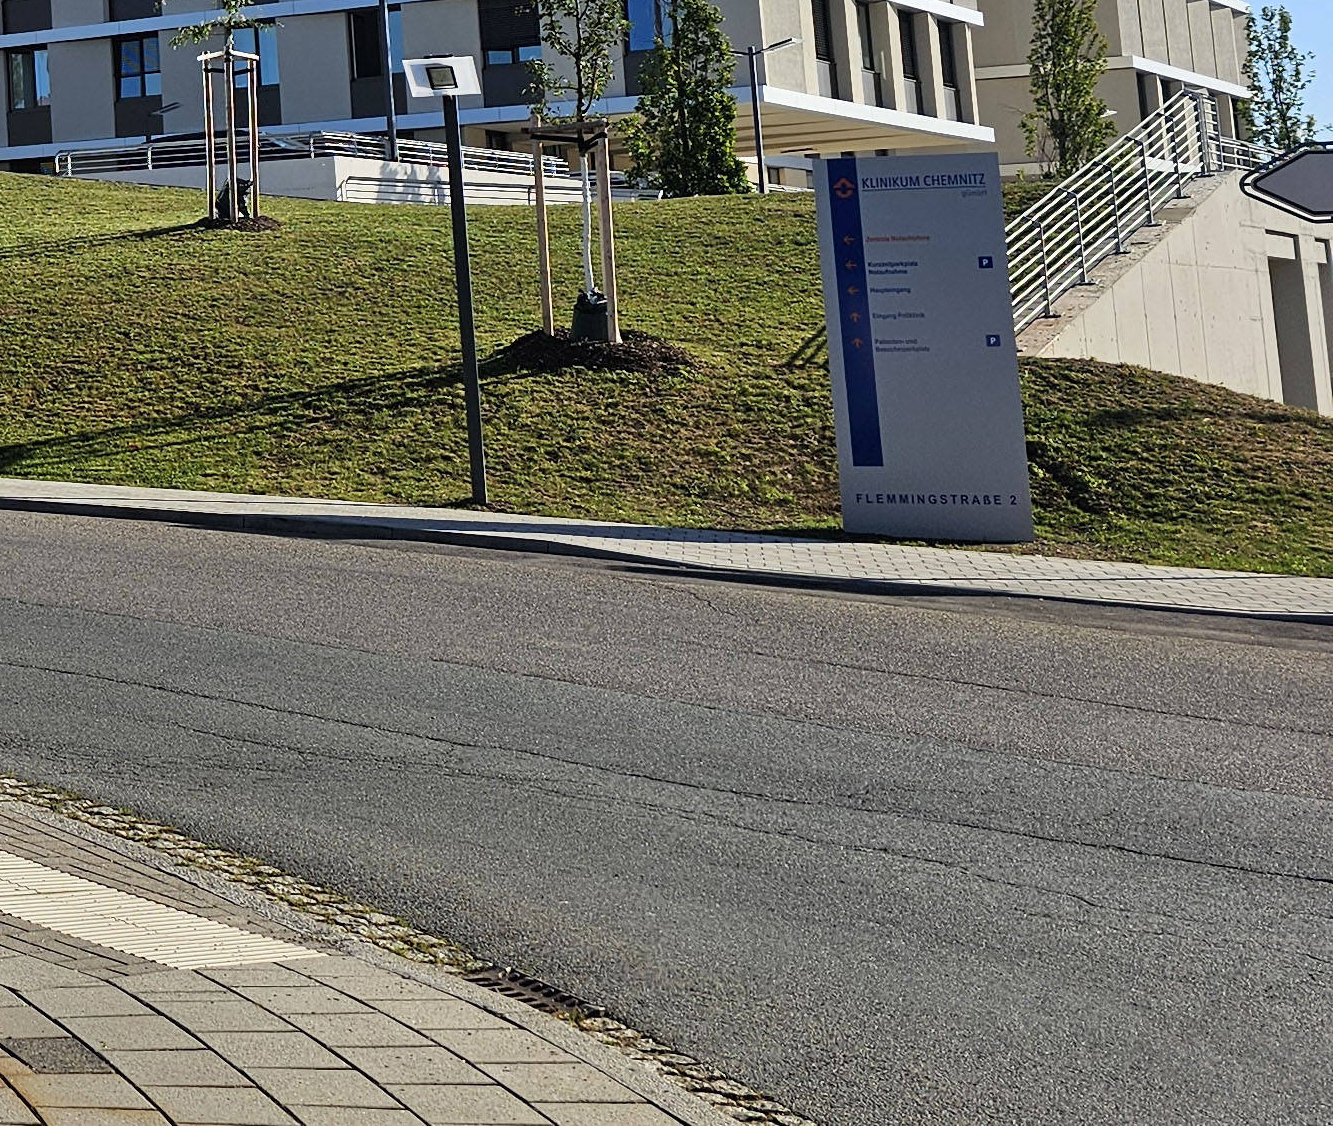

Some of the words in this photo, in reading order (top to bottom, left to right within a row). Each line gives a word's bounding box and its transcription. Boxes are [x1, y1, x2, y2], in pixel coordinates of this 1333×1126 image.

[861, 175, 920, 189] KLINIKUM
[923, 173, 986, 186] CHEMNITZ
[982, 258, 989, 266] P
[990, 336, 997, 345] P
[1009, 494, 1018, 506] 2
